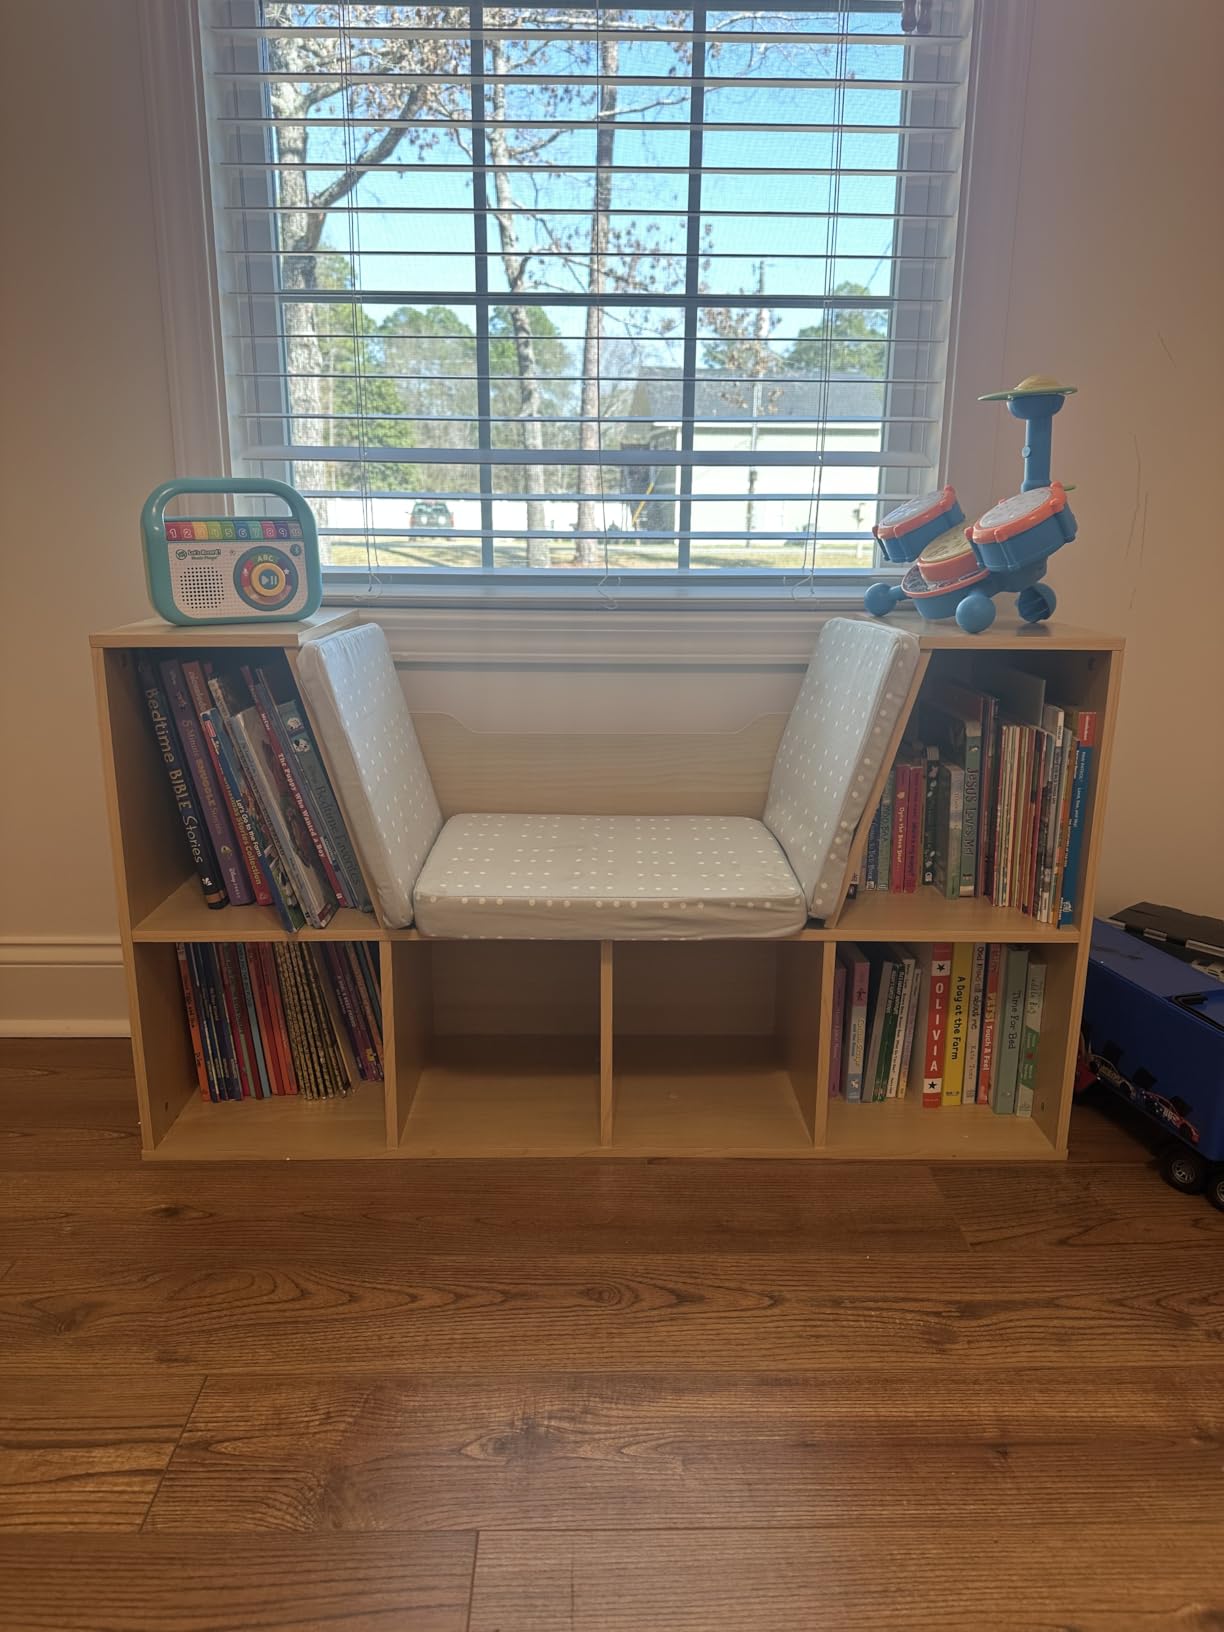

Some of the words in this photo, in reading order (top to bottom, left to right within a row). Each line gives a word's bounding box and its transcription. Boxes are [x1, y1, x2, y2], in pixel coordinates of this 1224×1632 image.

[169, 528, 177, 538] 1
[183, 528, 192, 538] 2
[225, 528, 233, 537] 5
[239, 528, 247, 537] 6
[266, 528, 274, 537] 8
[279, 528, 287, 537] 9
[145, 688, 175, 763] Bedtime
[168, 768, 192, 809] BIBLE
[182, 815, 205, 863] Stories
[235, 799, 247, 814] Let's
[278, 753, 288, 767] The
[283, 768, 297, 791] Puppy
[295, 793, 306, 810] Who
[301, 809, 316, 837] Wanted
[314, 844, 325, 858] Boy
[241, 814, 251, 824] Go
[248, 830, 257, 842] the
[233, 817, 249, 846] Stories
[244, 846, 263, 885] Collection
[251, 841, 263, 857] Farm
[954, 985, 965, 1002] Day
[955, 1005, 963, 1015] at
[930, 982, 944, 1073] OLIVIA
[954, 1018, 963, 1034] the
[984, 1025, 992, 1046] Touch
[952, 1037, 960, 1060] Farm
[983, 1055, 991, 1071] Feel
